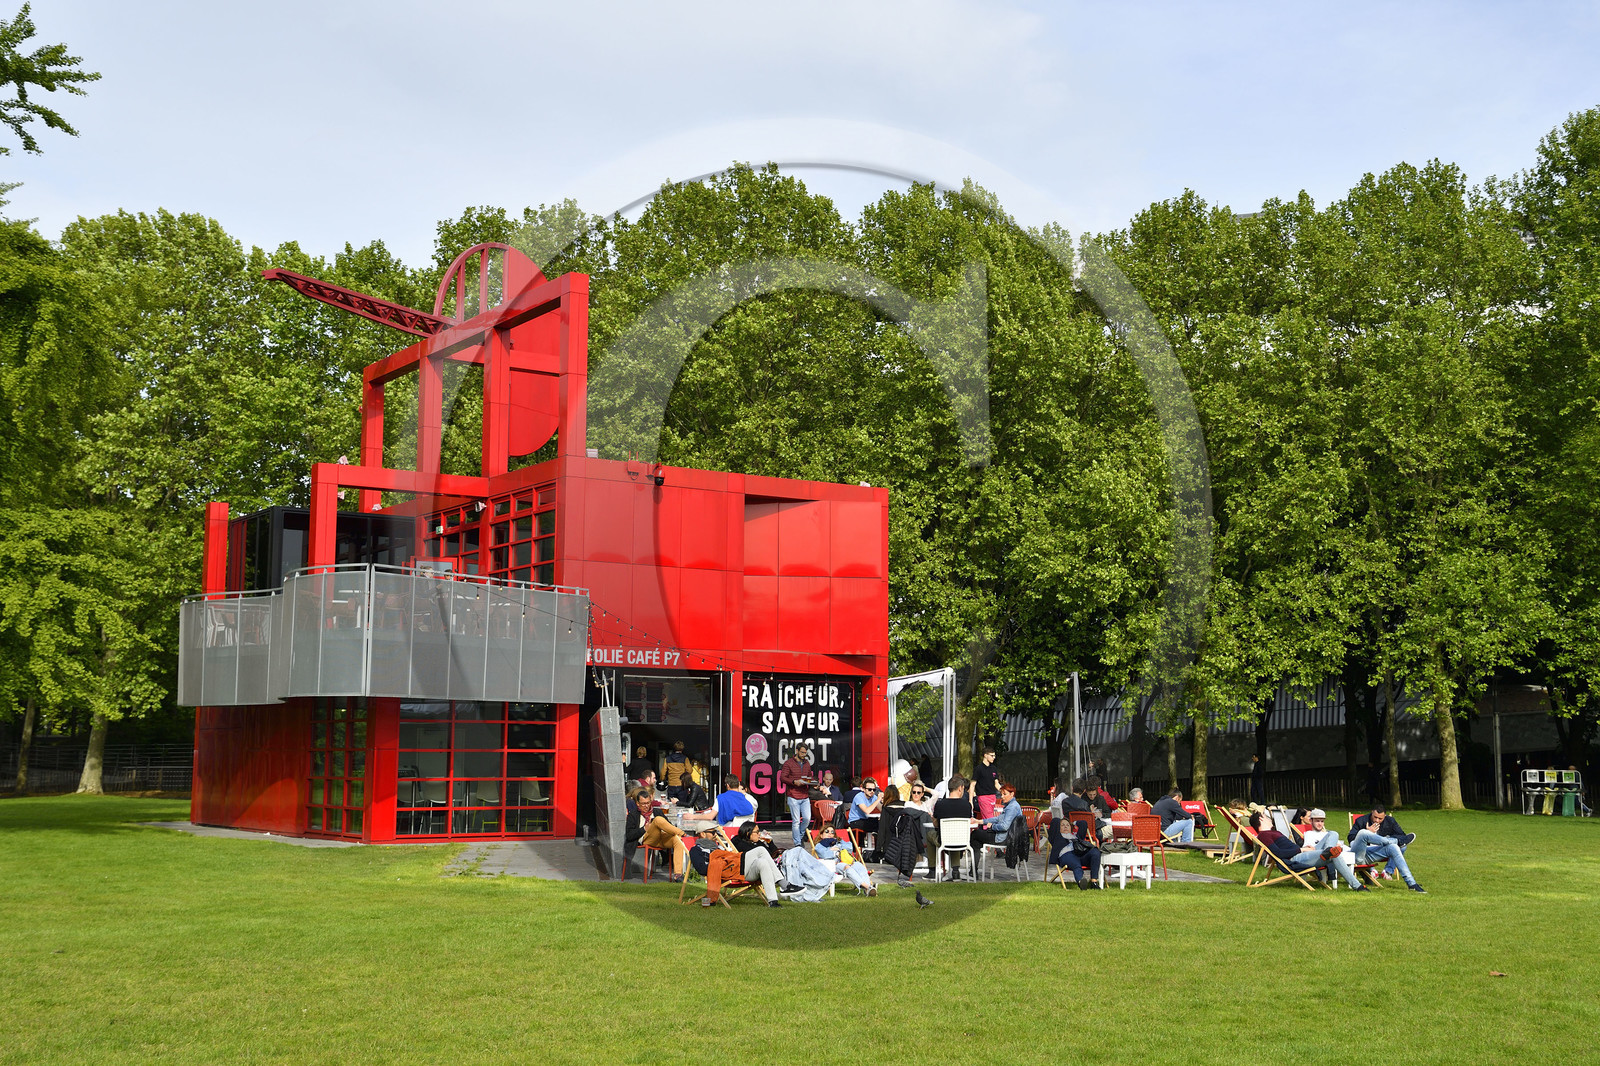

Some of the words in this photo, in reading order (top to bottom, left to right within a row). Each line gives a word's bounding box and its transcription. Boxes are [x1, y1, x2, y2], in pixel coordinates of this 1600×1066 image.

[586, 648, 624, 664] FOLIE
[627, 647, 661, 666] CAFÉ
[664, 651, 681, 666] P7
[761, 711, 840, 734] SAVEUR
[778, 737, 832, 766] C'ST
